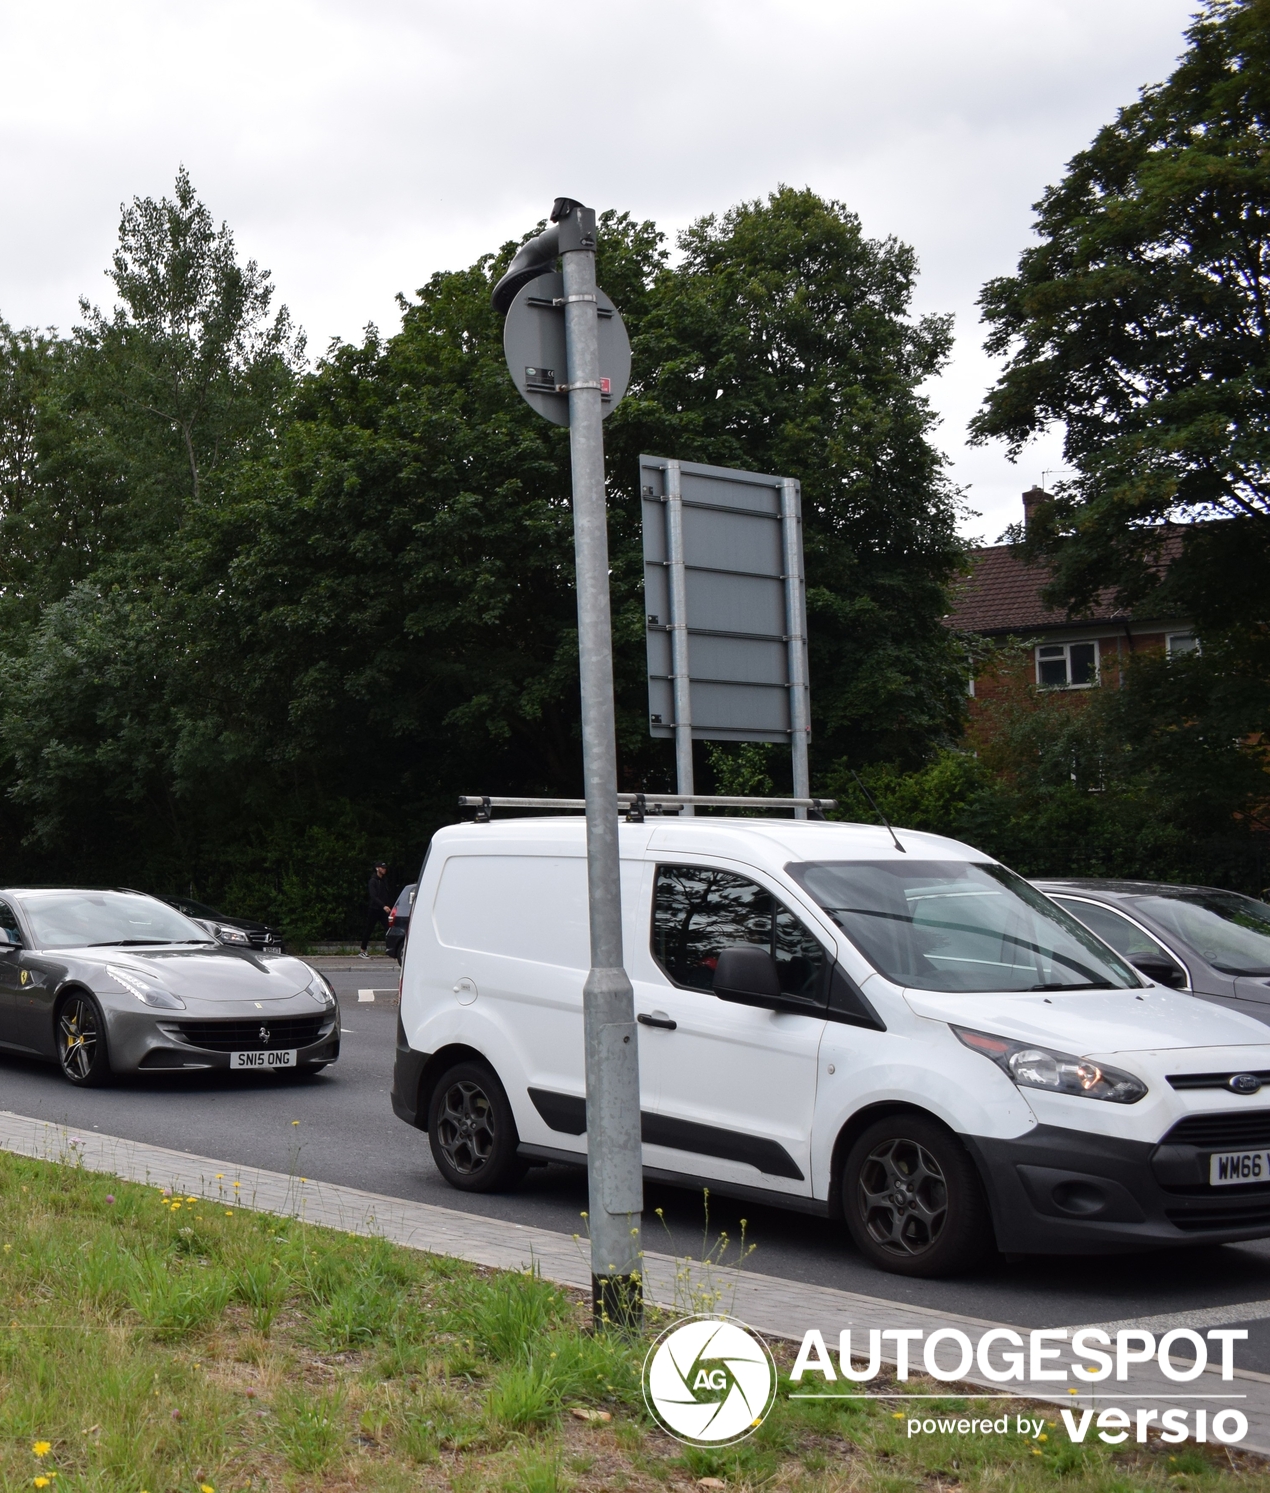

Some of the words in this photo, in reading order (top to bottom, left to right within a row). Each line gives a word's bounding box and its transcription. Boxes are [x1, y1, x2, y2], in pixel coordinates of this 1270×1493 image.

[238, 1053, 265, 1066] SN15
[268, 1052, 289, 1065] ONG
[1219, 1154, 1261, 1180] WM66
